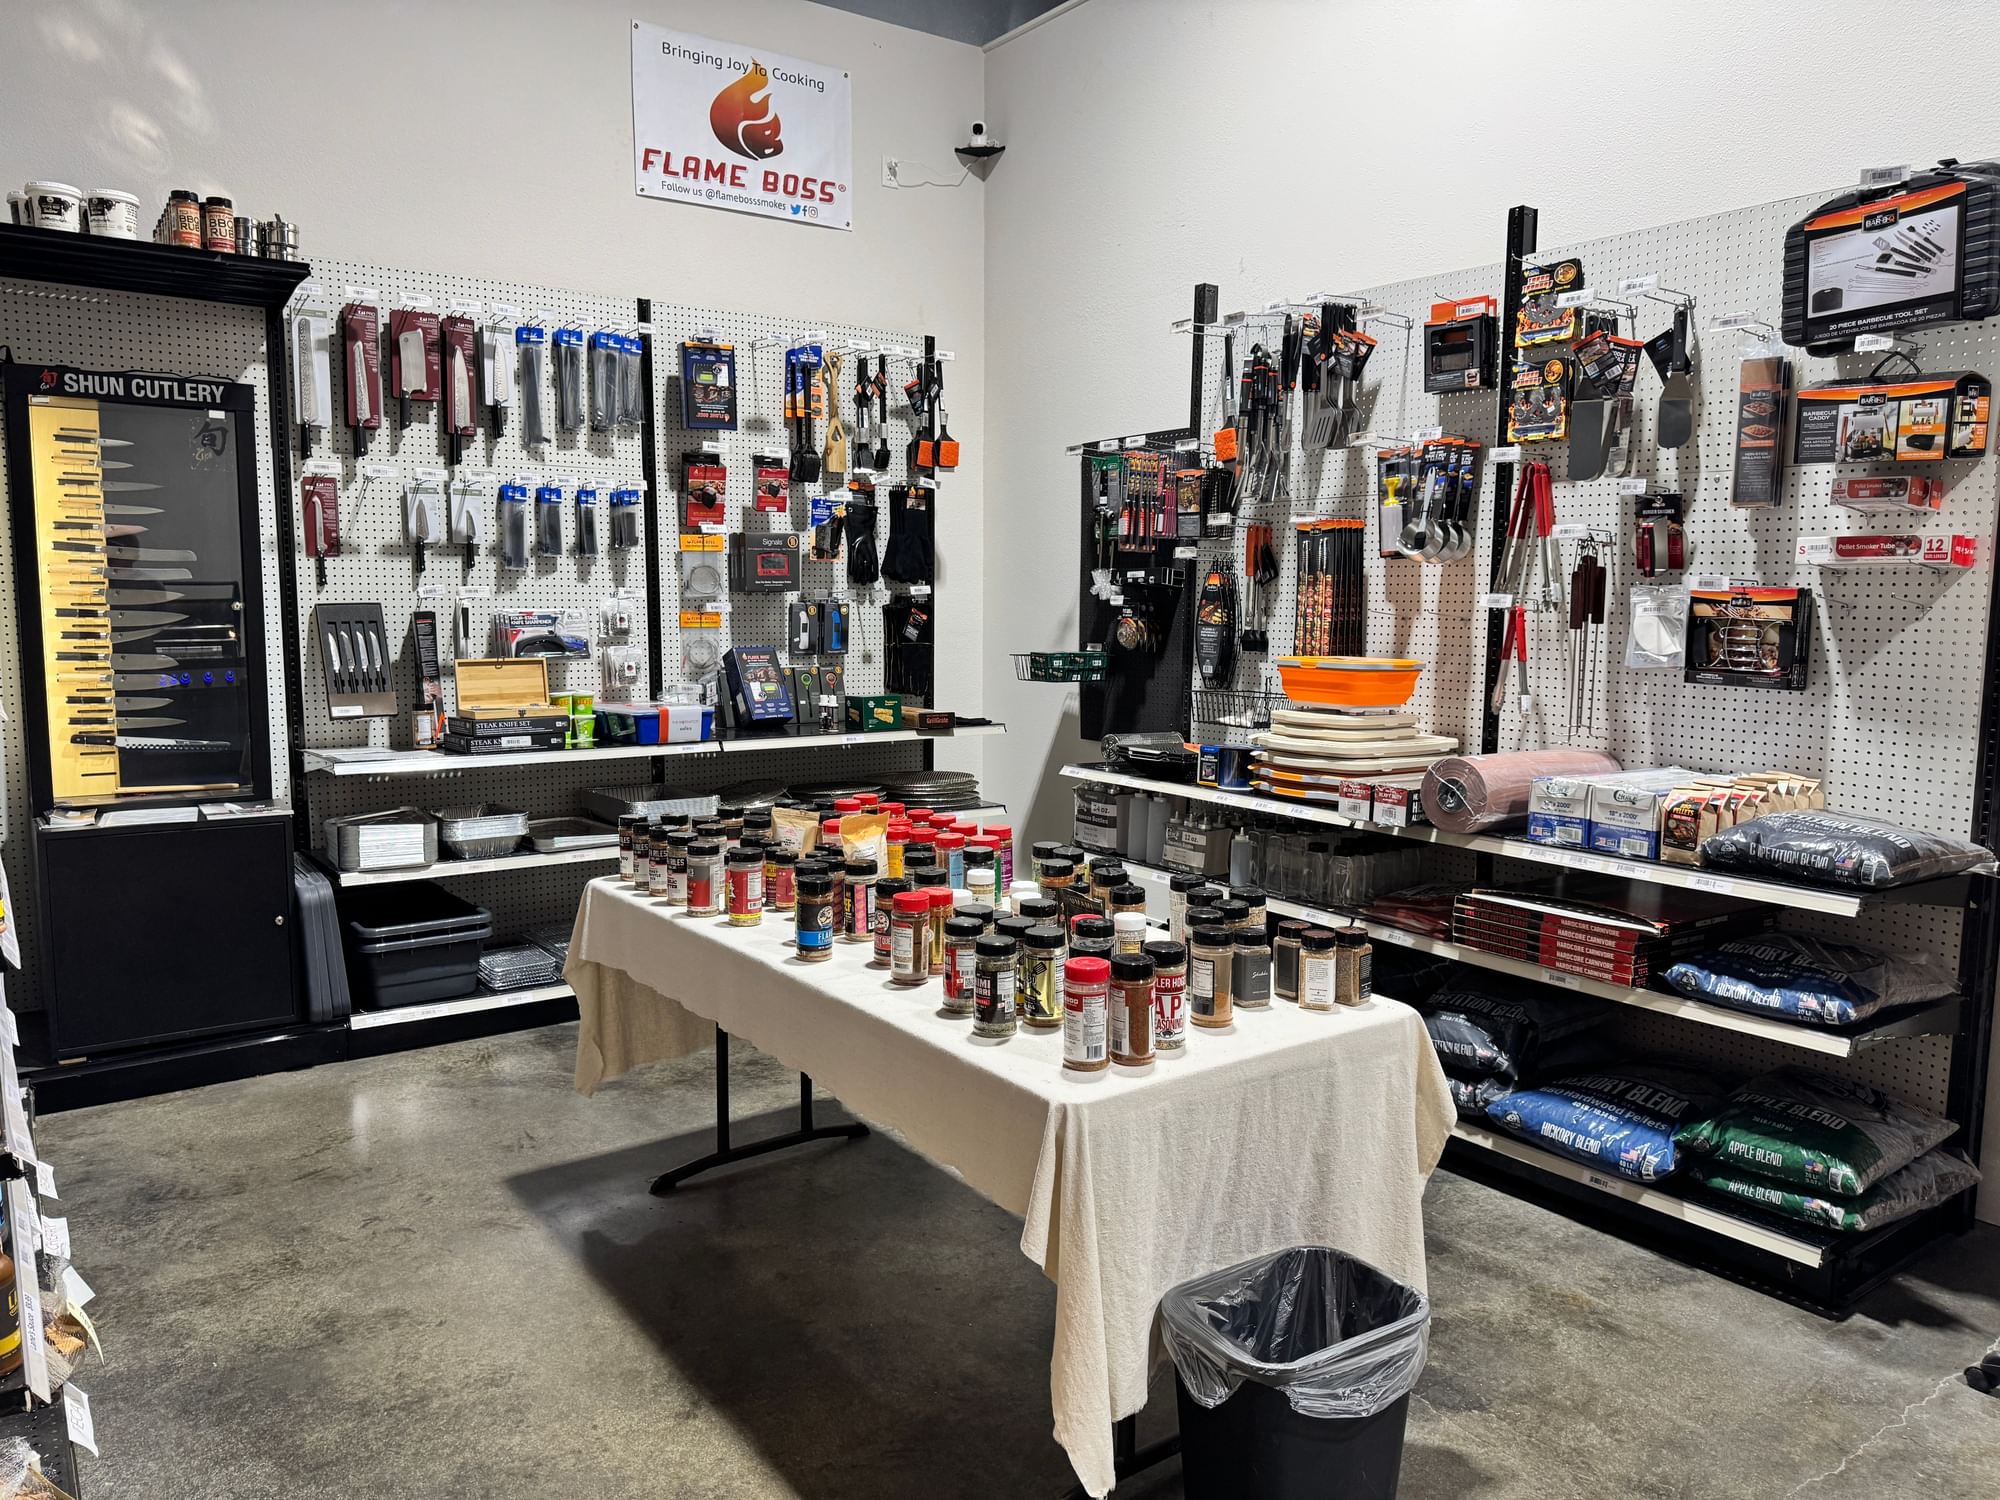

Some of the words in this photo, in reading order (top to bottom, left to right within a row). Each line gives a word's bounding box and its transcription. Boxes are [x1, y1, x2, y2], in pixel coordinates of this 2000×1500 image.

[662, 42, 722, 70] Bringing
[727, 58, 749, 75] Joy
[752, 62, 767, 77] To
[772, 68, 824, 92] Cooking
[642, 148, 748, 188] FLAME
[661, 180, 690, 194] Follow
[692, 186, 702, 197] us
[706, 188, 786, 210] @flamebosssmokes
[210, 218, 234, 229] BBQ
[1838, 320, 1856, 329] PIECE
[1858, 314, 1894, 326] BARBECUE
[1894, 310, 1913, 320] TOOL
[1914, 308, 1928, 316] SET
[64, 372, 124, 396] SHUN
[131, 378, 224, 404] CUTLERY
[1926, 538, 1944, 551] 12
[1850, 824, 1912, 848] BLEND
[1801, 852, 1829, 869] BLEND
[1558, 929, 1585, 941] HARDCORE
[1586, 934, 1616, 948] CARNIVORE
[1561, 919, 1590, 930] HARDCORE
[1591, 924, 1620, 937] CARNIVORE
[1556, 941, 1584, 952] HARDCORE
[1585, 946, 1615, 959] CARNIVORE
[1556, 951, 1584, 963] HARDCORE
[1585, 957, 1614, 970] CARNIVORE
[1555, 962, 1584, 973] HARDCORE
[1585, 967, 1613, 980] CARNIVORE
[1716, 982, 1751, 1001] HICKORY
[1753, 992, 1781, 1008] BLEND
[1454, 1043, 1473, 1056] BLEND
[1566, 1089, 1624, 1116] Hardwood
[1626, 1110, 1668, 1131] Pellets
[1629, 1084, 1688, 1118] BLEND
[1731, 1094, 1791, 1110] APPLE
[1788, 1104, 1848, 1130] BLEND
[1541, 1121, 1575, 1144] HICKORY
[1576, 1135, 1601, 1155] BLEND
[1728, 1141, 1755, 1160] APPLE
[1756, 1146, 1782, 1167] BLEND
[1728, 1180, 1753, 1197] APPLE
[1755, 1186, 1782, 1205] BLEND
